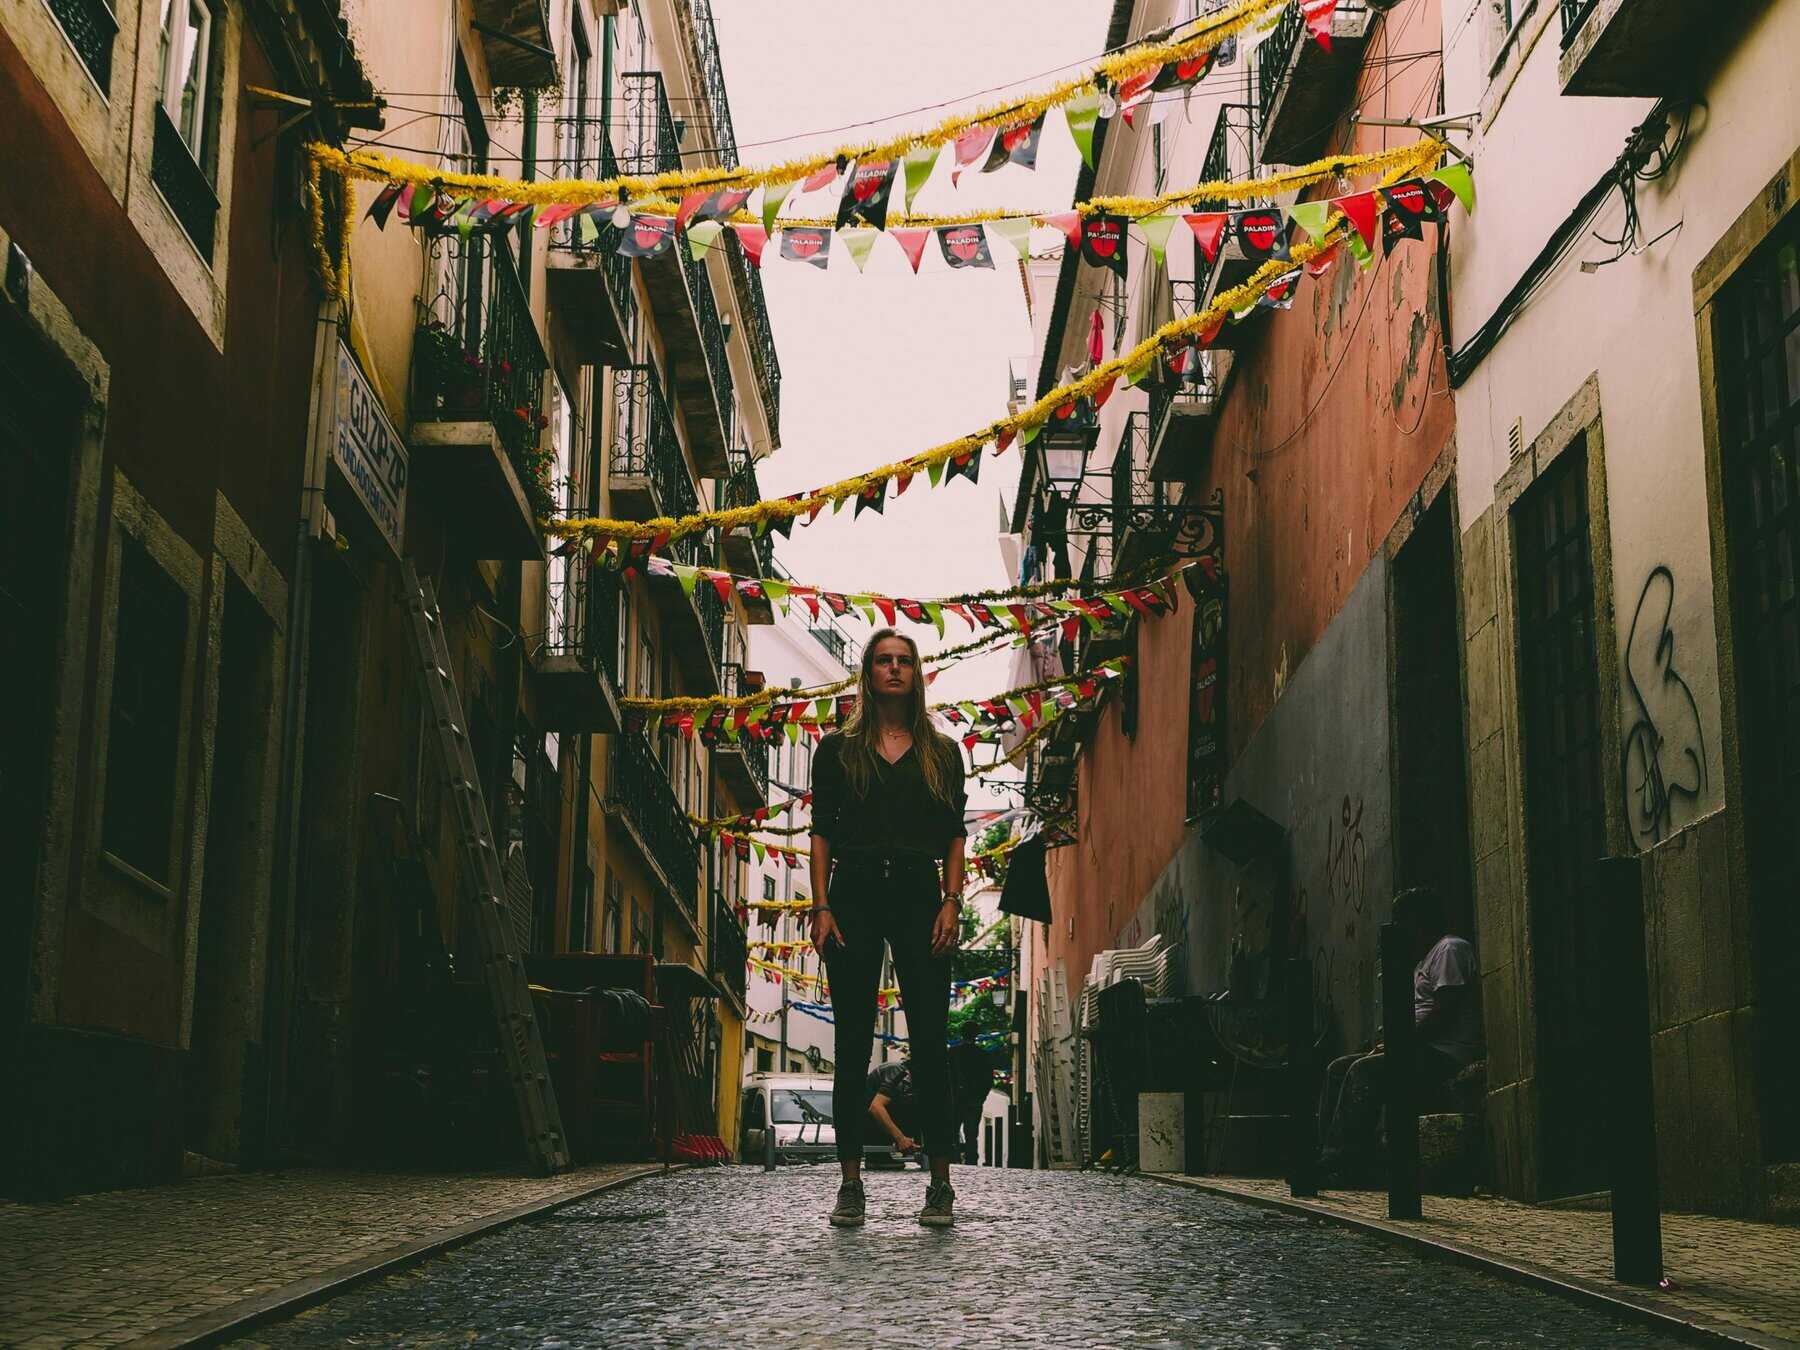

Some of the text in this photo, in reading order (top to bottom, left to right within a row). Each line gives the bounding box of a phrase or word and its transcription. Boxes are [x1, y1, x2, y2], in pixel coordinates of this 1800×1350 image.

[1392, 189, 1424, 200] PALADIN
[1243, 224, 1277, 232] PALADIN
[789, 238, 823, 246] PALADIN
[946, 236, 980, 245] PALADIN
